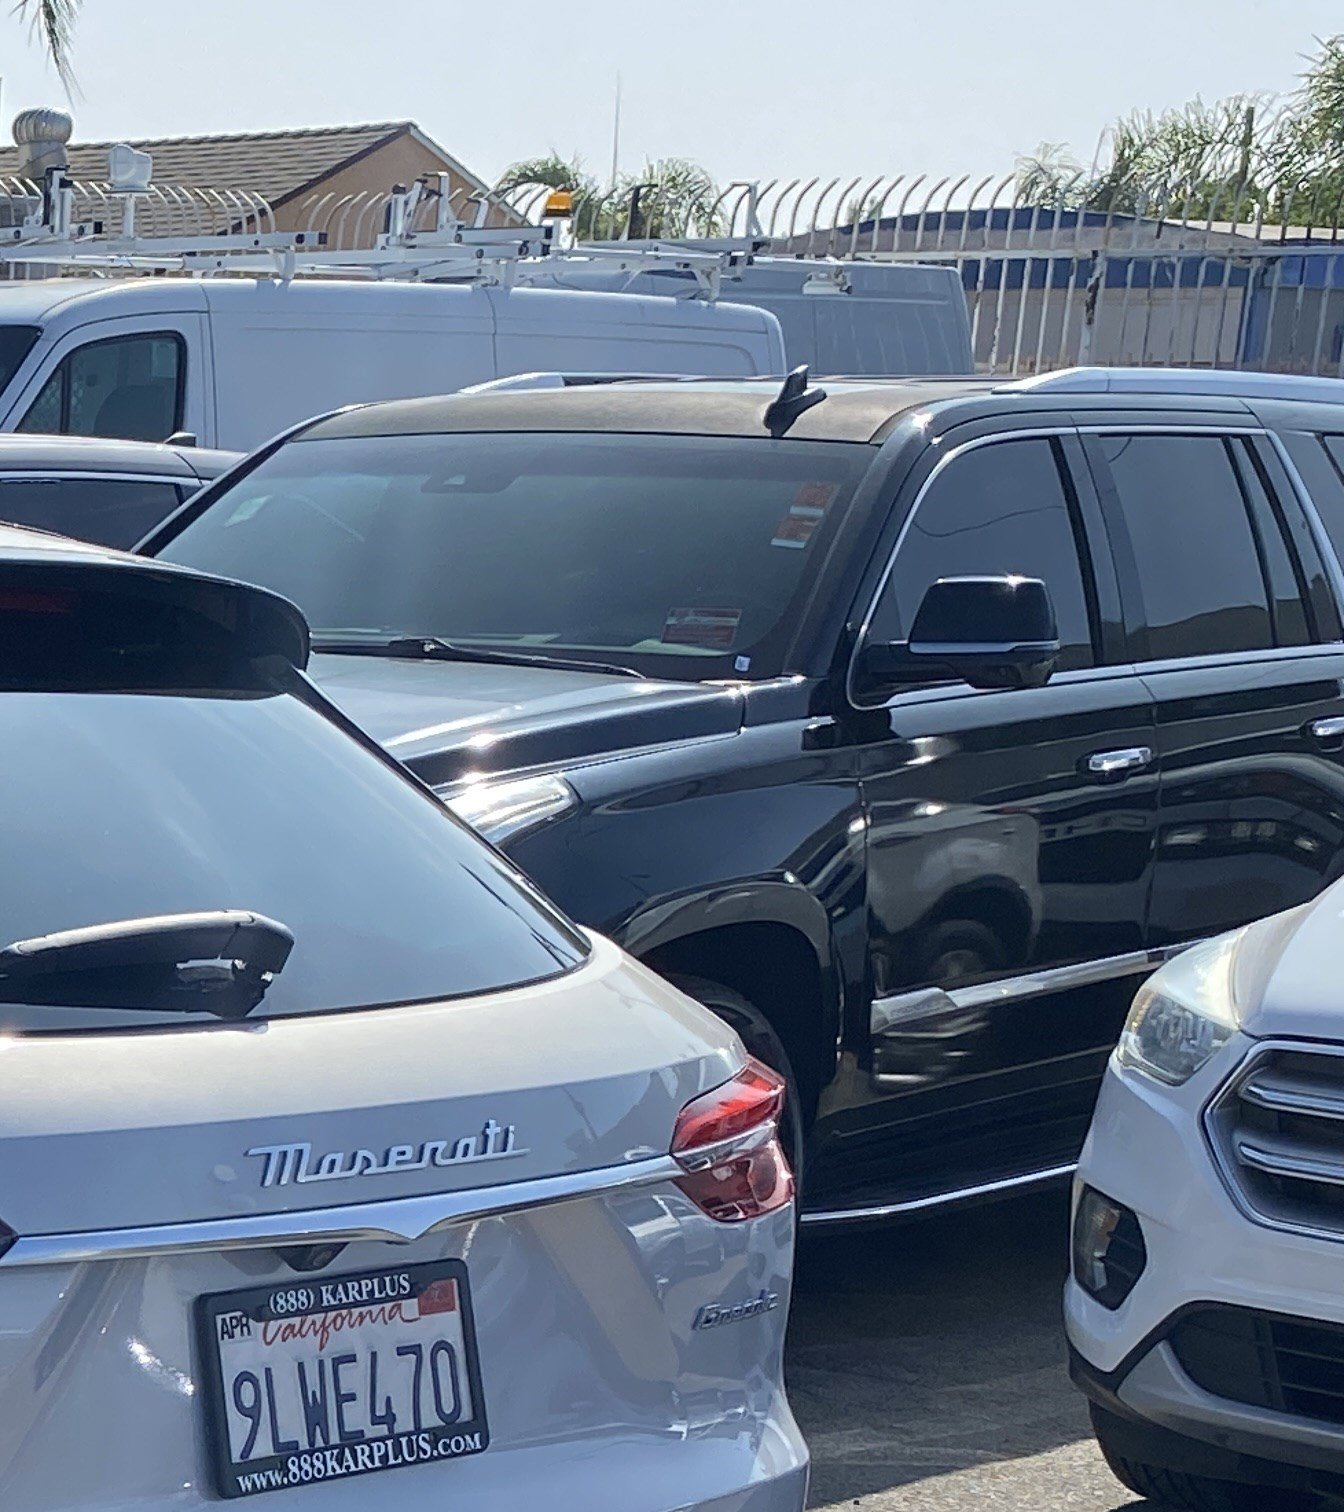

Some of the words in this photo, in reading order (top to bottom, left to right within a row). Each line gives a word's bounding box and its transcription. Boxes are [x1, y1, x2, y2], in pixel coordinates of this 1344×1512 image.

[247, 1119, 530, 1187] Maserati
[268, 1287, 315, 1315] (888)
[320, 1273, 412, 1308] KARPLUS
[219, 1314, 252, 1342] APR
[262, 1301, 421, 1352] California
[232, 1339, 462, 1460] 9LWE470
